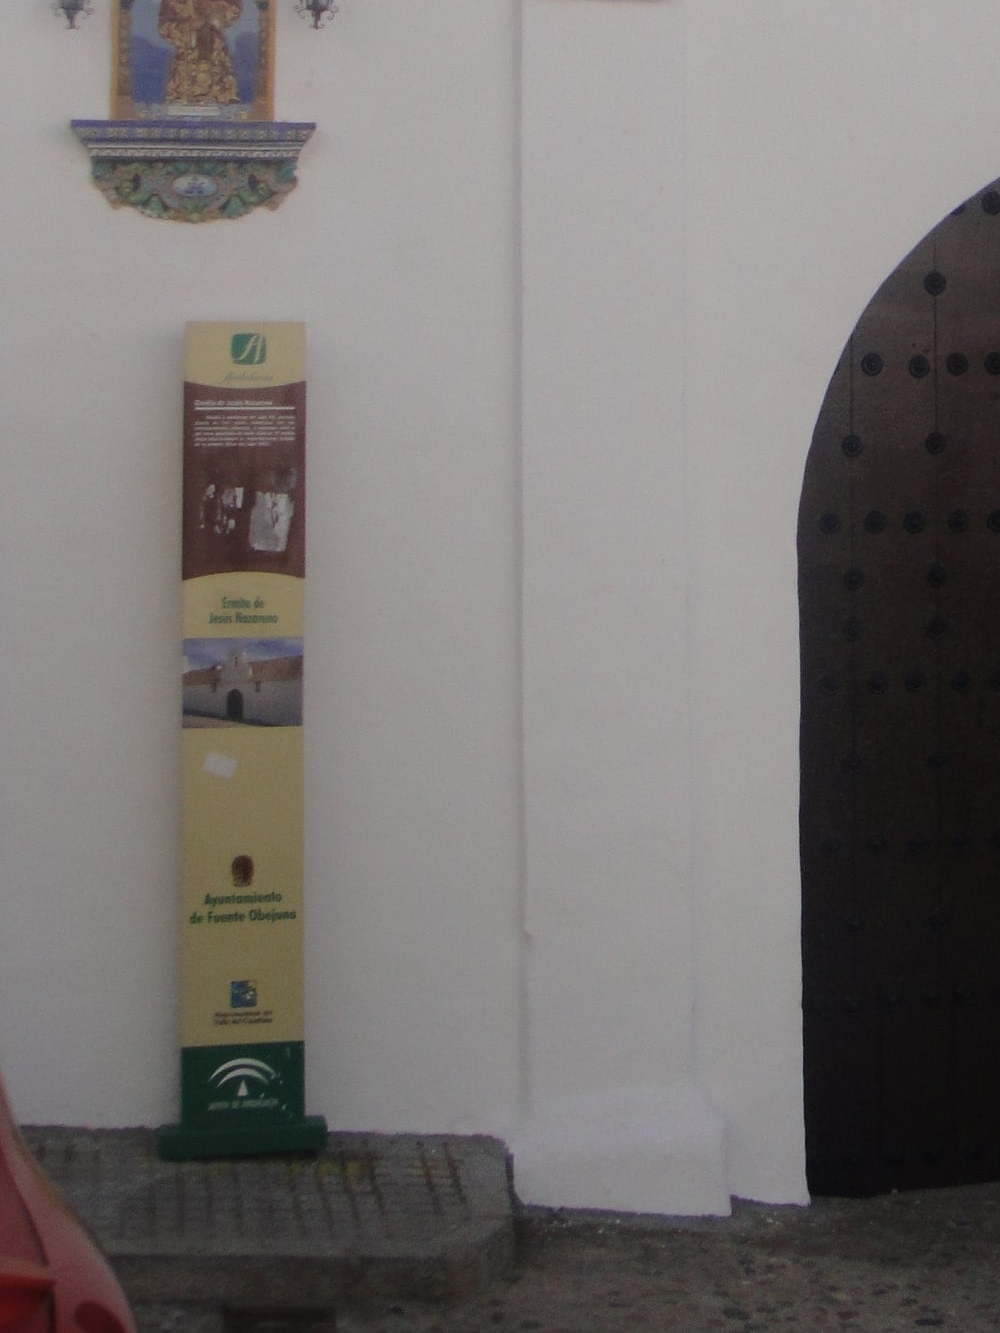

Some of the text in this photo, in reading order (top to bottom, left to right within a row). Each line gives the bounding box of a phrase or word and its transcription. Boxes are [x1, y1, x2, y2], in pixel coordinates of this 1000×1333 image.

[222, 596, 264, 608] Ermita de
[235, 613, 278, 623] Nazareno
[204, 892, 282, 906] Ayuntamiento
[189, 908, 297, 923] de Fuente Obejuna
